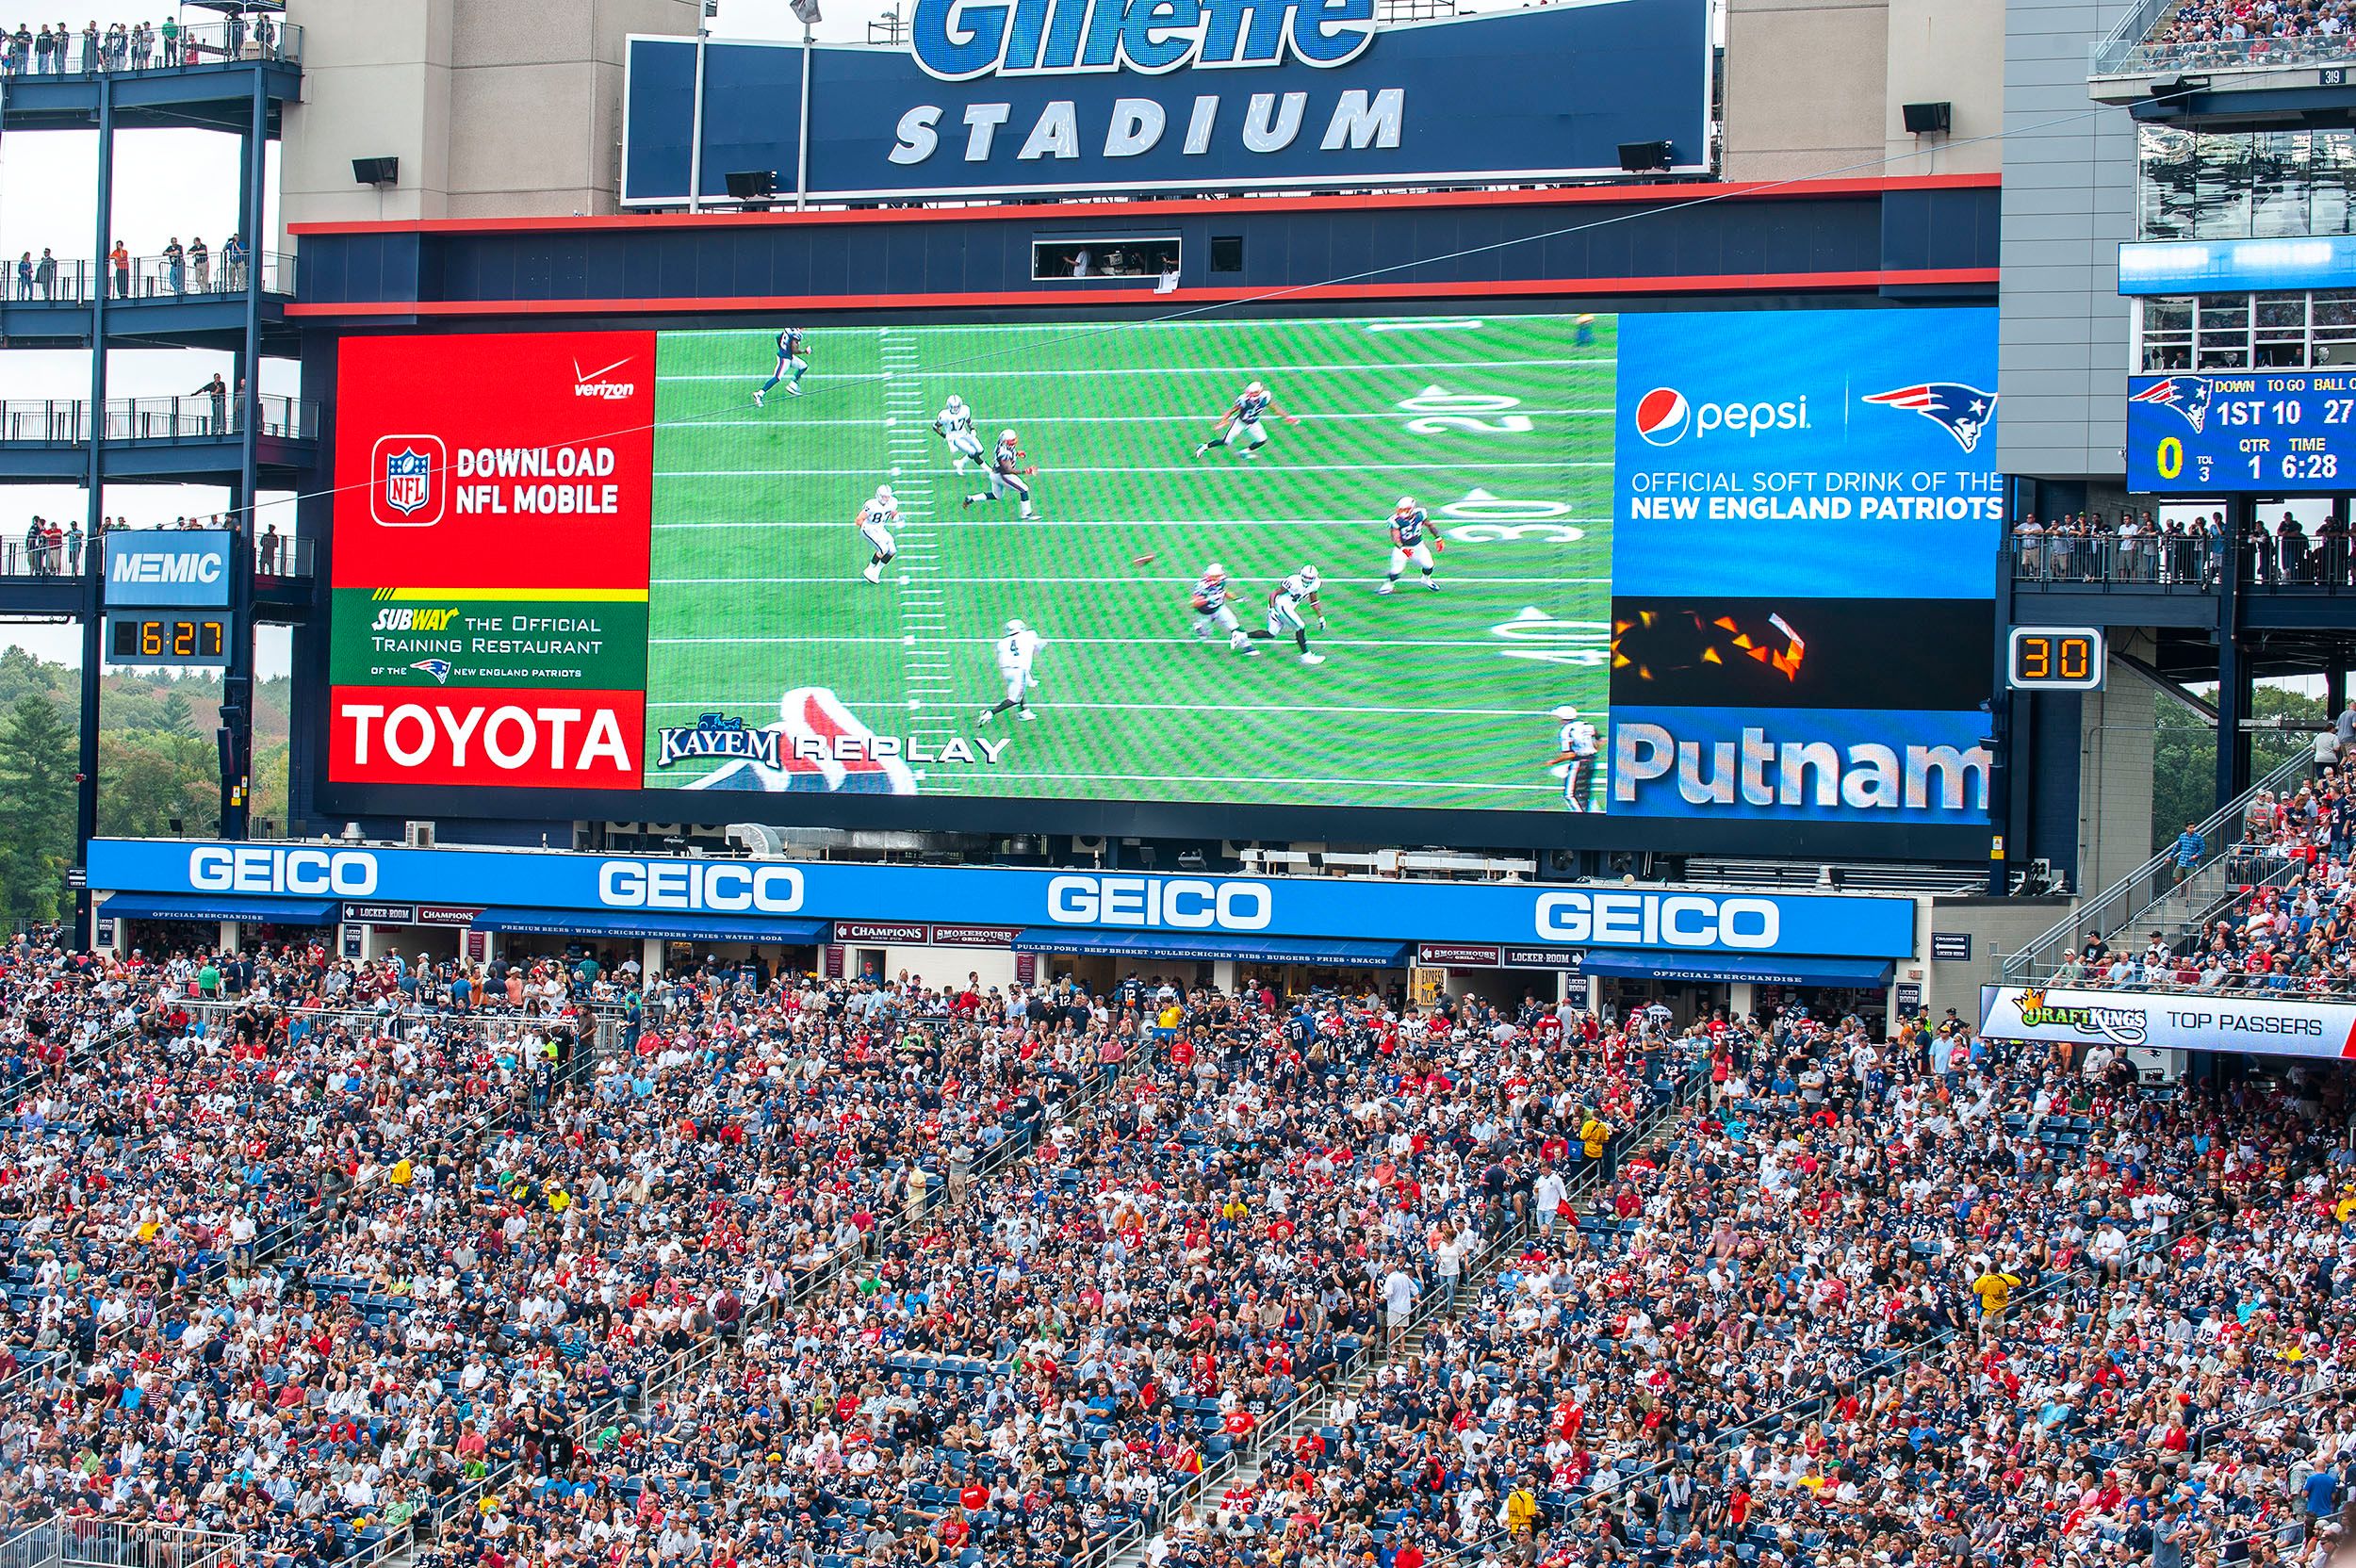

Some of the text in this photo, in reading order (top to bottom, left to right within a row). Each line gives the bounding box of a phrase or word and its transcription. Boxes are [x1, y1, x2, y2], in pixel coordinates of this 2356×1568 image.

[909, 0, 1378, 81] Gillette
[2325, 70, 2340, 84] 319
[887, 88, 1405, 165] STADIUM
[574, 380, 634, 400] verizon
[2215, 381, 2255, 393] DOWN
[2267, 380, 2283, 391] TO
[2286, 379, 2306, 391] GO
[2314, 378, 2346, 391] BALL
[1696, 395, 1808, 438] pepsi
[2217, 399, 2354, 425] 1ST 10 27
[950, 418, 966, 432] 17
[2239, 437, 2326, 452] QTR TIME
[456, 447, 615, 478] DOWNLOAD
[2157, 436, 2184, 479] 0
[2197, 455, 2214, 465] TOL
[2249, 453, 2337, 479] 1 6:28
[1631, 471, 2004, 492] OFFICIAL SOFT DRINK OF THE
[2199, 466, 2210, 482] 3
[391, 477, 424, 501] NFL
[455, 484, 618, 514] NFL MOBILE
[873, 512, 892, 524] 87
[1631, 496, 2004, 520] NEW ENGLAND PATRIOTS
[113, 552, 221, 583] MEMIC
[371, 607, 460, 631] SUBWAY
[465, 617, 502, 632] THE
[142, 622, 221, 655] 6:27
[1010, 640, 1019, 656] 4
[2025, 639, 2087, 678] 30
[387, 667, 407, 676] THE
[453, 668, 477, 677] NEW
[479, 668, 530, 678] ENGLAND
[532, 669, 581, 678] PATRIOTS
[341, 703, 632, 772] TOYOTA
[658, 727, 1011, 769] KAYEM REPLAY
[1614, 722, 1993, 810] Putnam
[189, 847, 378, 896] GEICO
[598, 861, 805, 912] GEICO
[360, 907, 409, 919] LOCKER ROOM
[1047, 875, 1272, 930] GEICO
[152, 911, 264, 921] OFFICIAL MERCHANDISE
[422, 910, 474, 921] CHAMPIONS
[1535, 892, 1780, 948] GEICO
[851, 926, 922, 939] CHAMPIONS
[937, 929, 1012, 941] SMOKEHOUSE
[1434, 949, 1497, 960] SMOKEHOUSE
[1512, 953, 1570, 963] LOCKER ROOM
[1421, 970, 1444, 984] EXPRESS
[1568, 984, 1587, 992] ROOM
[1653, 971, 1803, 983] OFFICIAL MERCHANDISE
[2167, 1011, 2213, 1028] TOP
[2219, 1015, 2322, 1037] PASSERS
